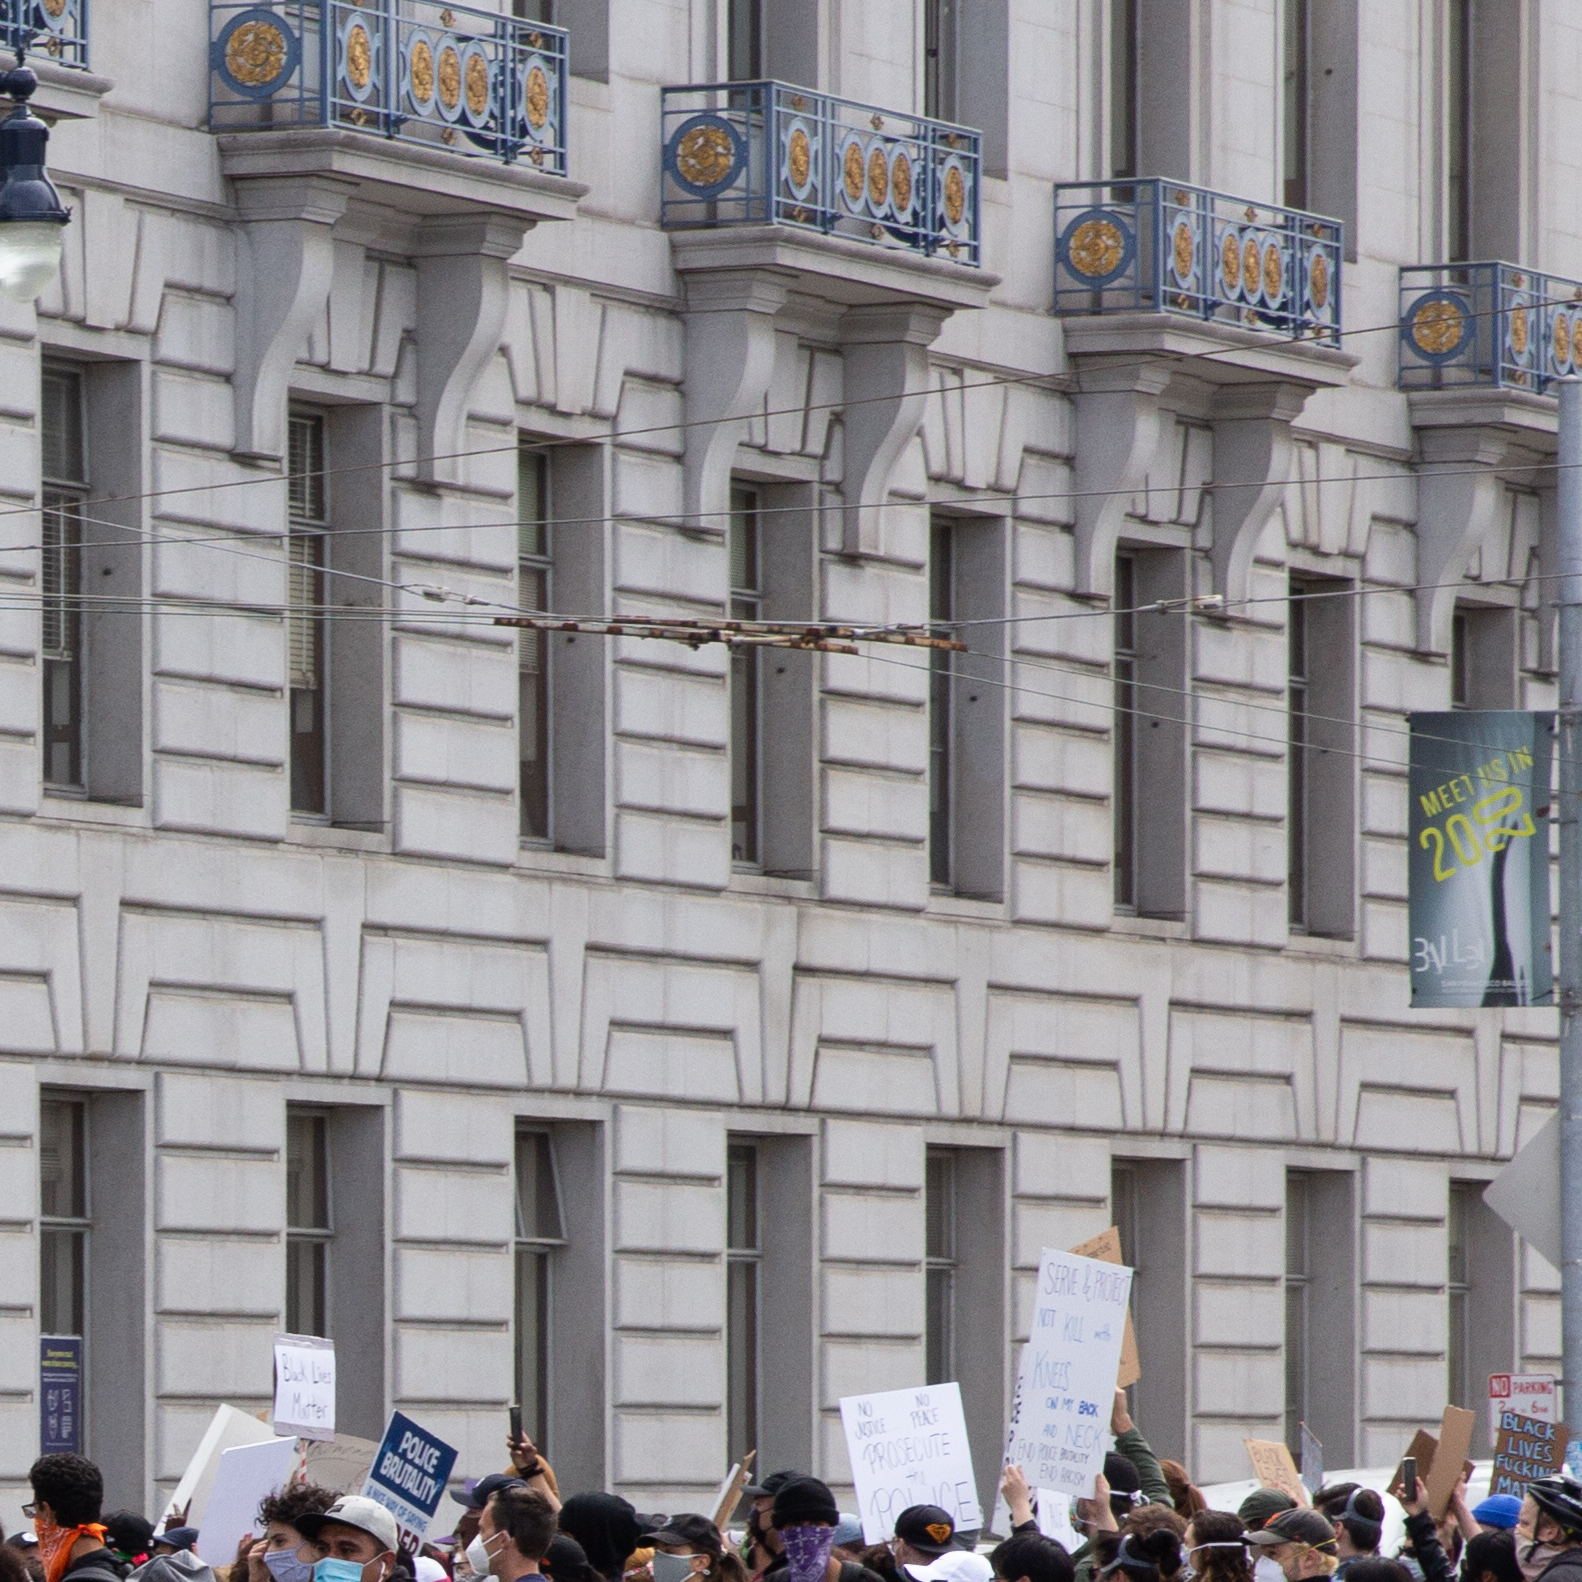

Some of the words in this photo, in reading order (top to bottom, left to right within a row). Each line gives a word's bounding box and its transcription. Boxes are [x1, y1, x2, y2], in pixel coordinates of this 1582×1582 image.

[1419, 774, 1475, 818] MEET
[1477, 757, 1510, 792] US
[1506, 746, 1535, 777] IN
[282, 1353, 309, 1384] Black
[1491, 1376, 1508, 1396] NO
[1512, 1381, 1553, 1395] PARKING
[858, 1401, 873, 1418] NO
[914, 1392, 931, 1408] NO
[1078, 1400, 1099, 1417] BACK
[1065, 1423, 1107, 1456] NECK
[1502, 1412, 1556, 1441] BLACK
[399, 1430, 442, 1474] POLICE
[862, 1432, 951, 1475] PROSECUTE
[1507, 1436, 1554, 1463] LIVES
[379, 1451, 440, 1505] BRUTALITY
